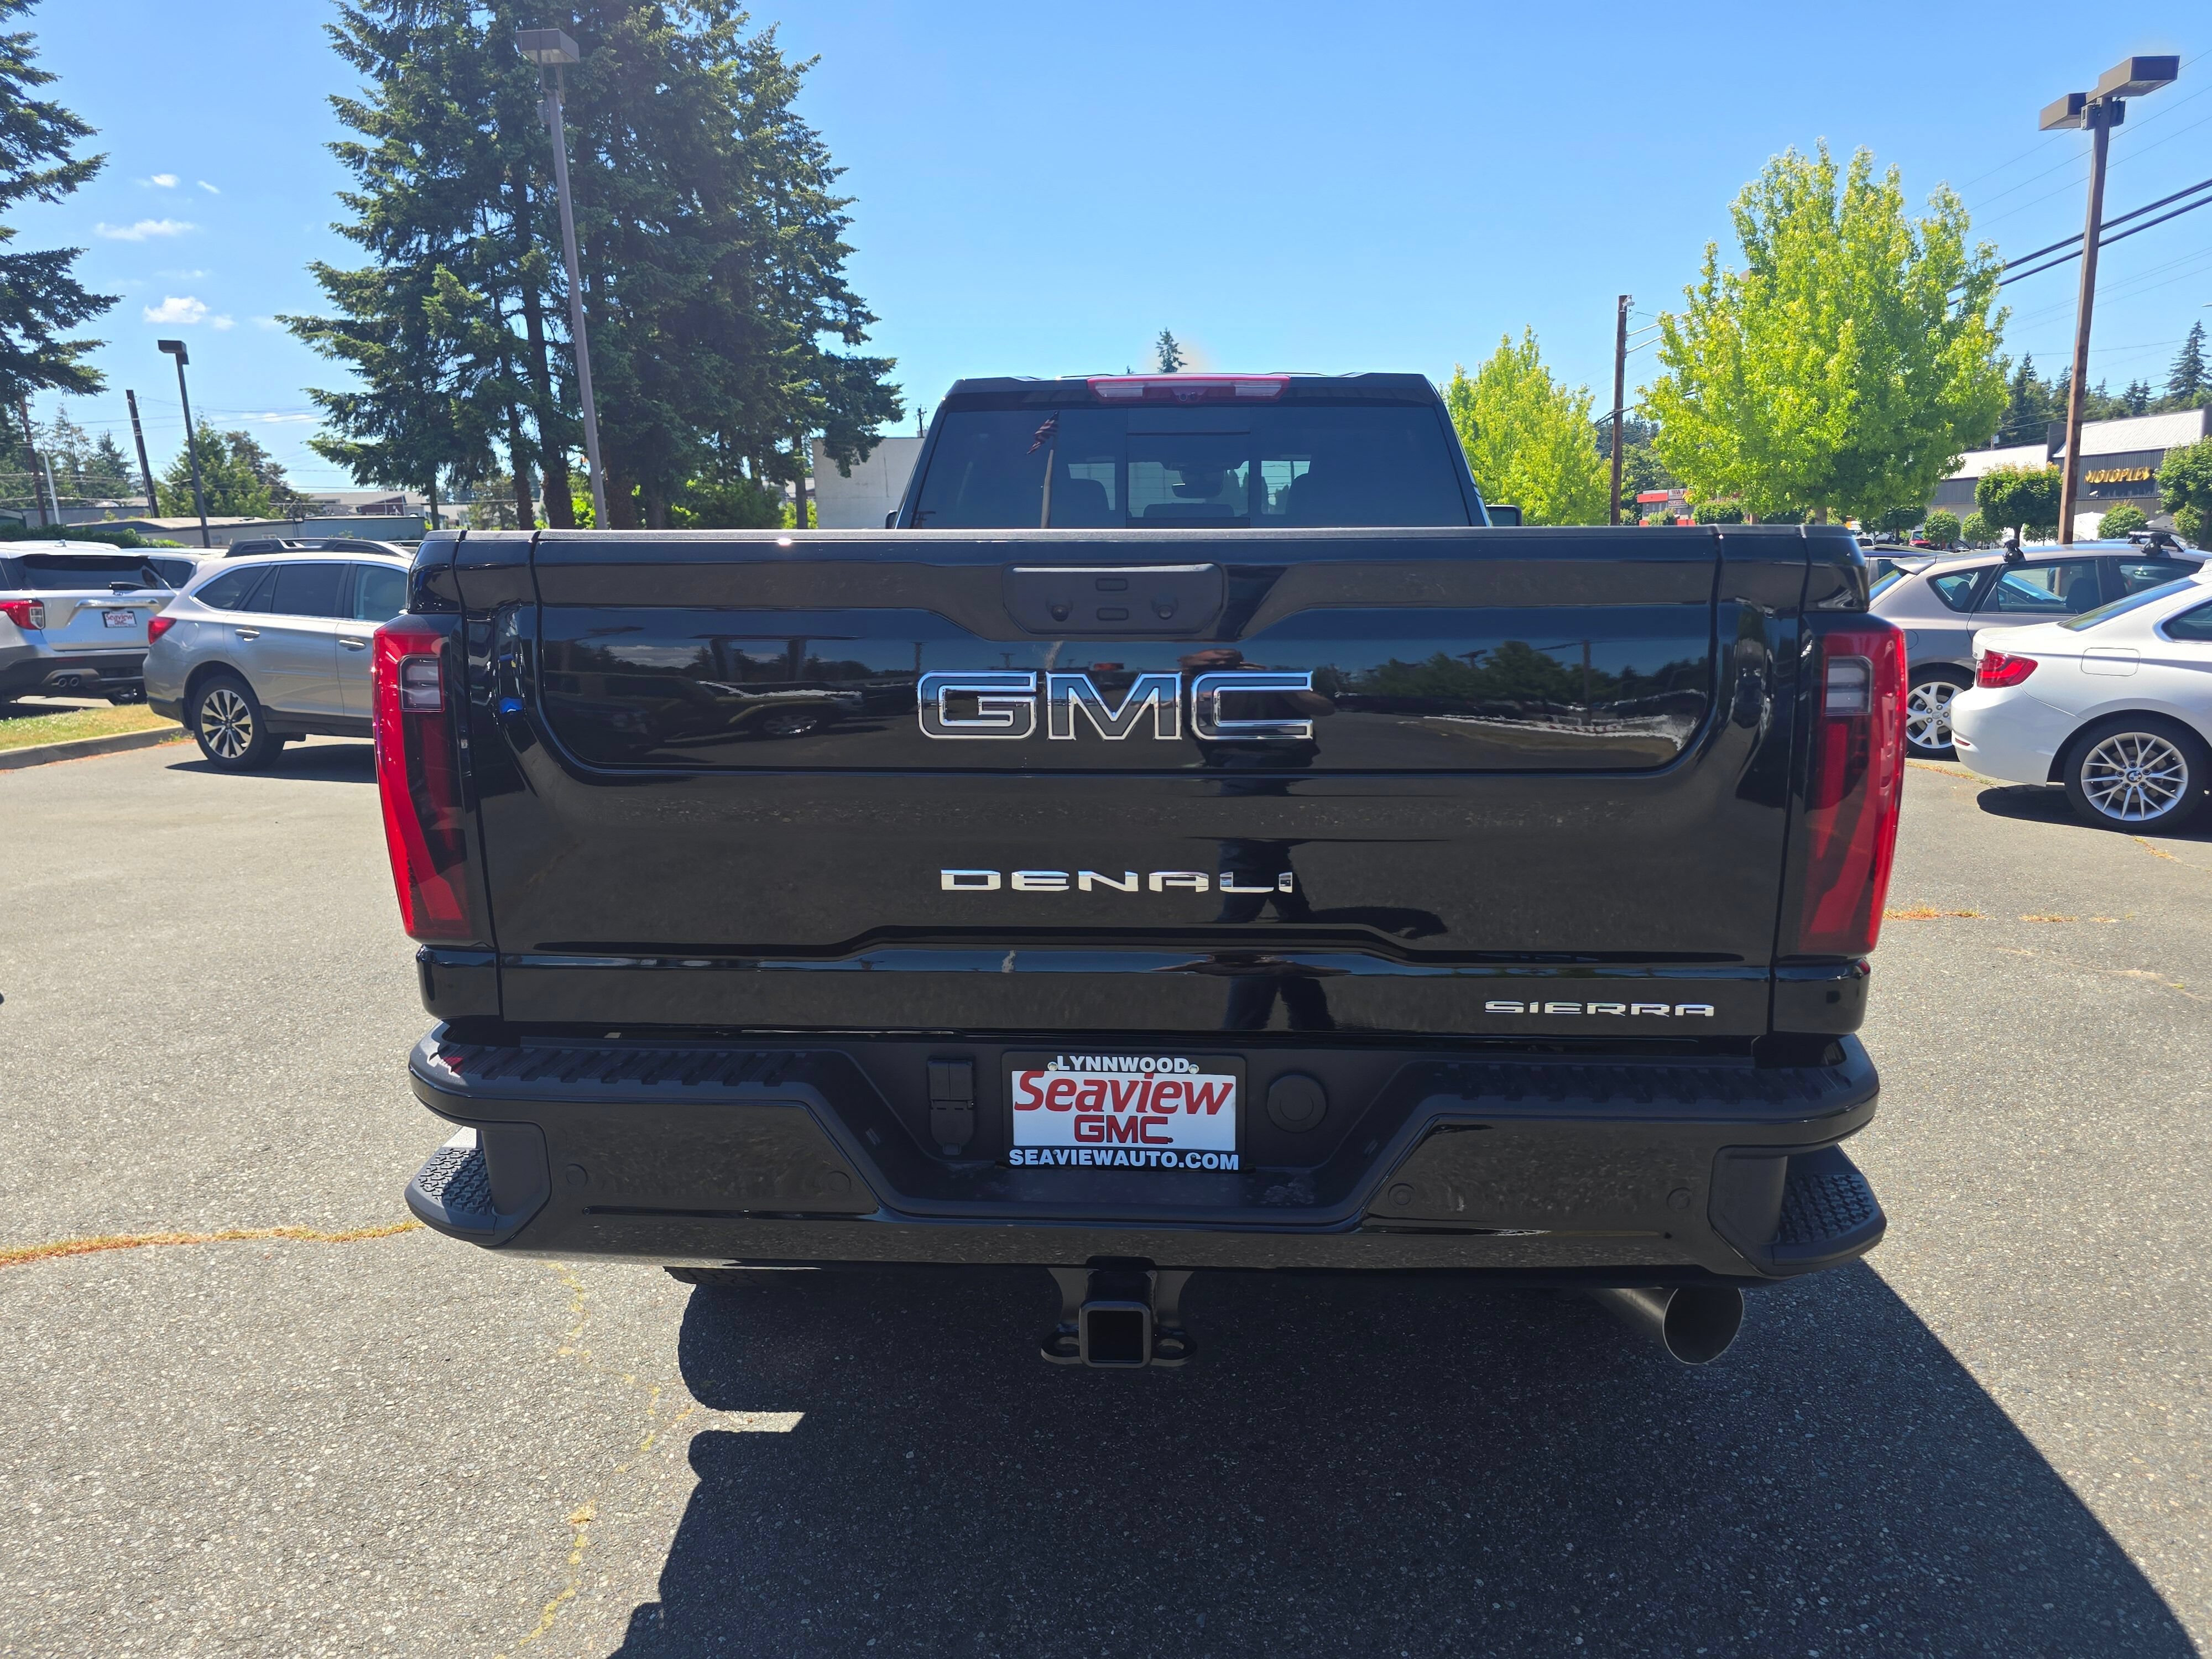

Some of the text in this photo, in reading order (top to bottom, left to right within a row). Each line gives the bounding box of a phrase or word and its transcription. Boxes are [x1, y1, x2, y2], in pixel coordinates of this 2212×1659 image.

[917, 670, 1313, 740] GMC
[941, 869, 1293, 893] DENALI
[1485, 1001, 1714, 1017] SIERRA
[1057, 1056, 1190, 1073] LYNNWOOD
[1014, 1071, 1234, 1115] Seaview
[1074, 1114, 1171, 1144] GMC
[1009, 1149, 1239, 1170] SEAVIEWAUTO.COM
